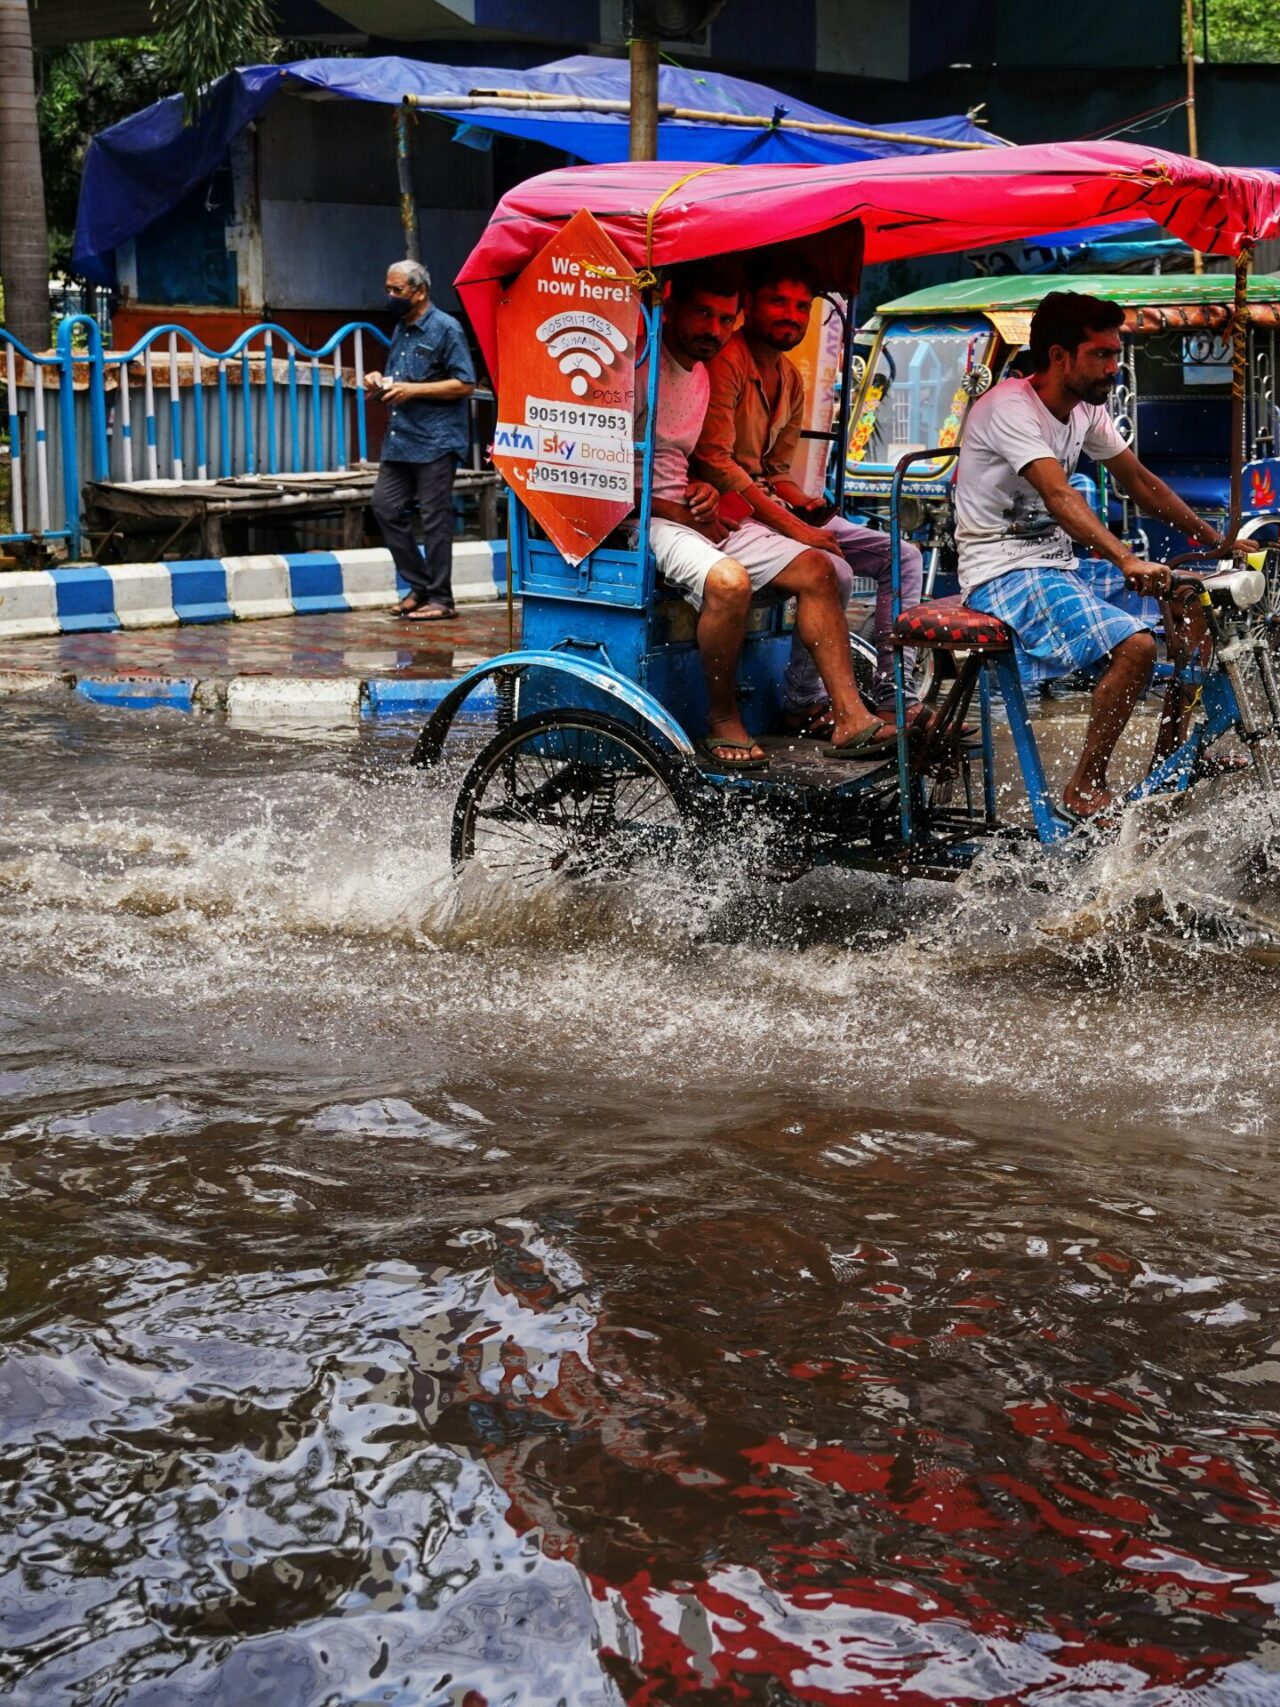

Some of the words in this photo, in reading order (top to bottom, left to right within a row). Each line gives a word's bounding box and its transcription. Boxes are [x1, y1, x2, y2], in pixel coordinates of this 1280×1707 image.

[551, 256, 580, 276] We
[585, 264, 617, 279] are
[537, 278, 575, 296] now
[580, 279, 631, 302] here!
[528, 406, 626, 431] 9051917953
[495, 431, 534, 450] ATA
[543, 431, 576, 460] sky
